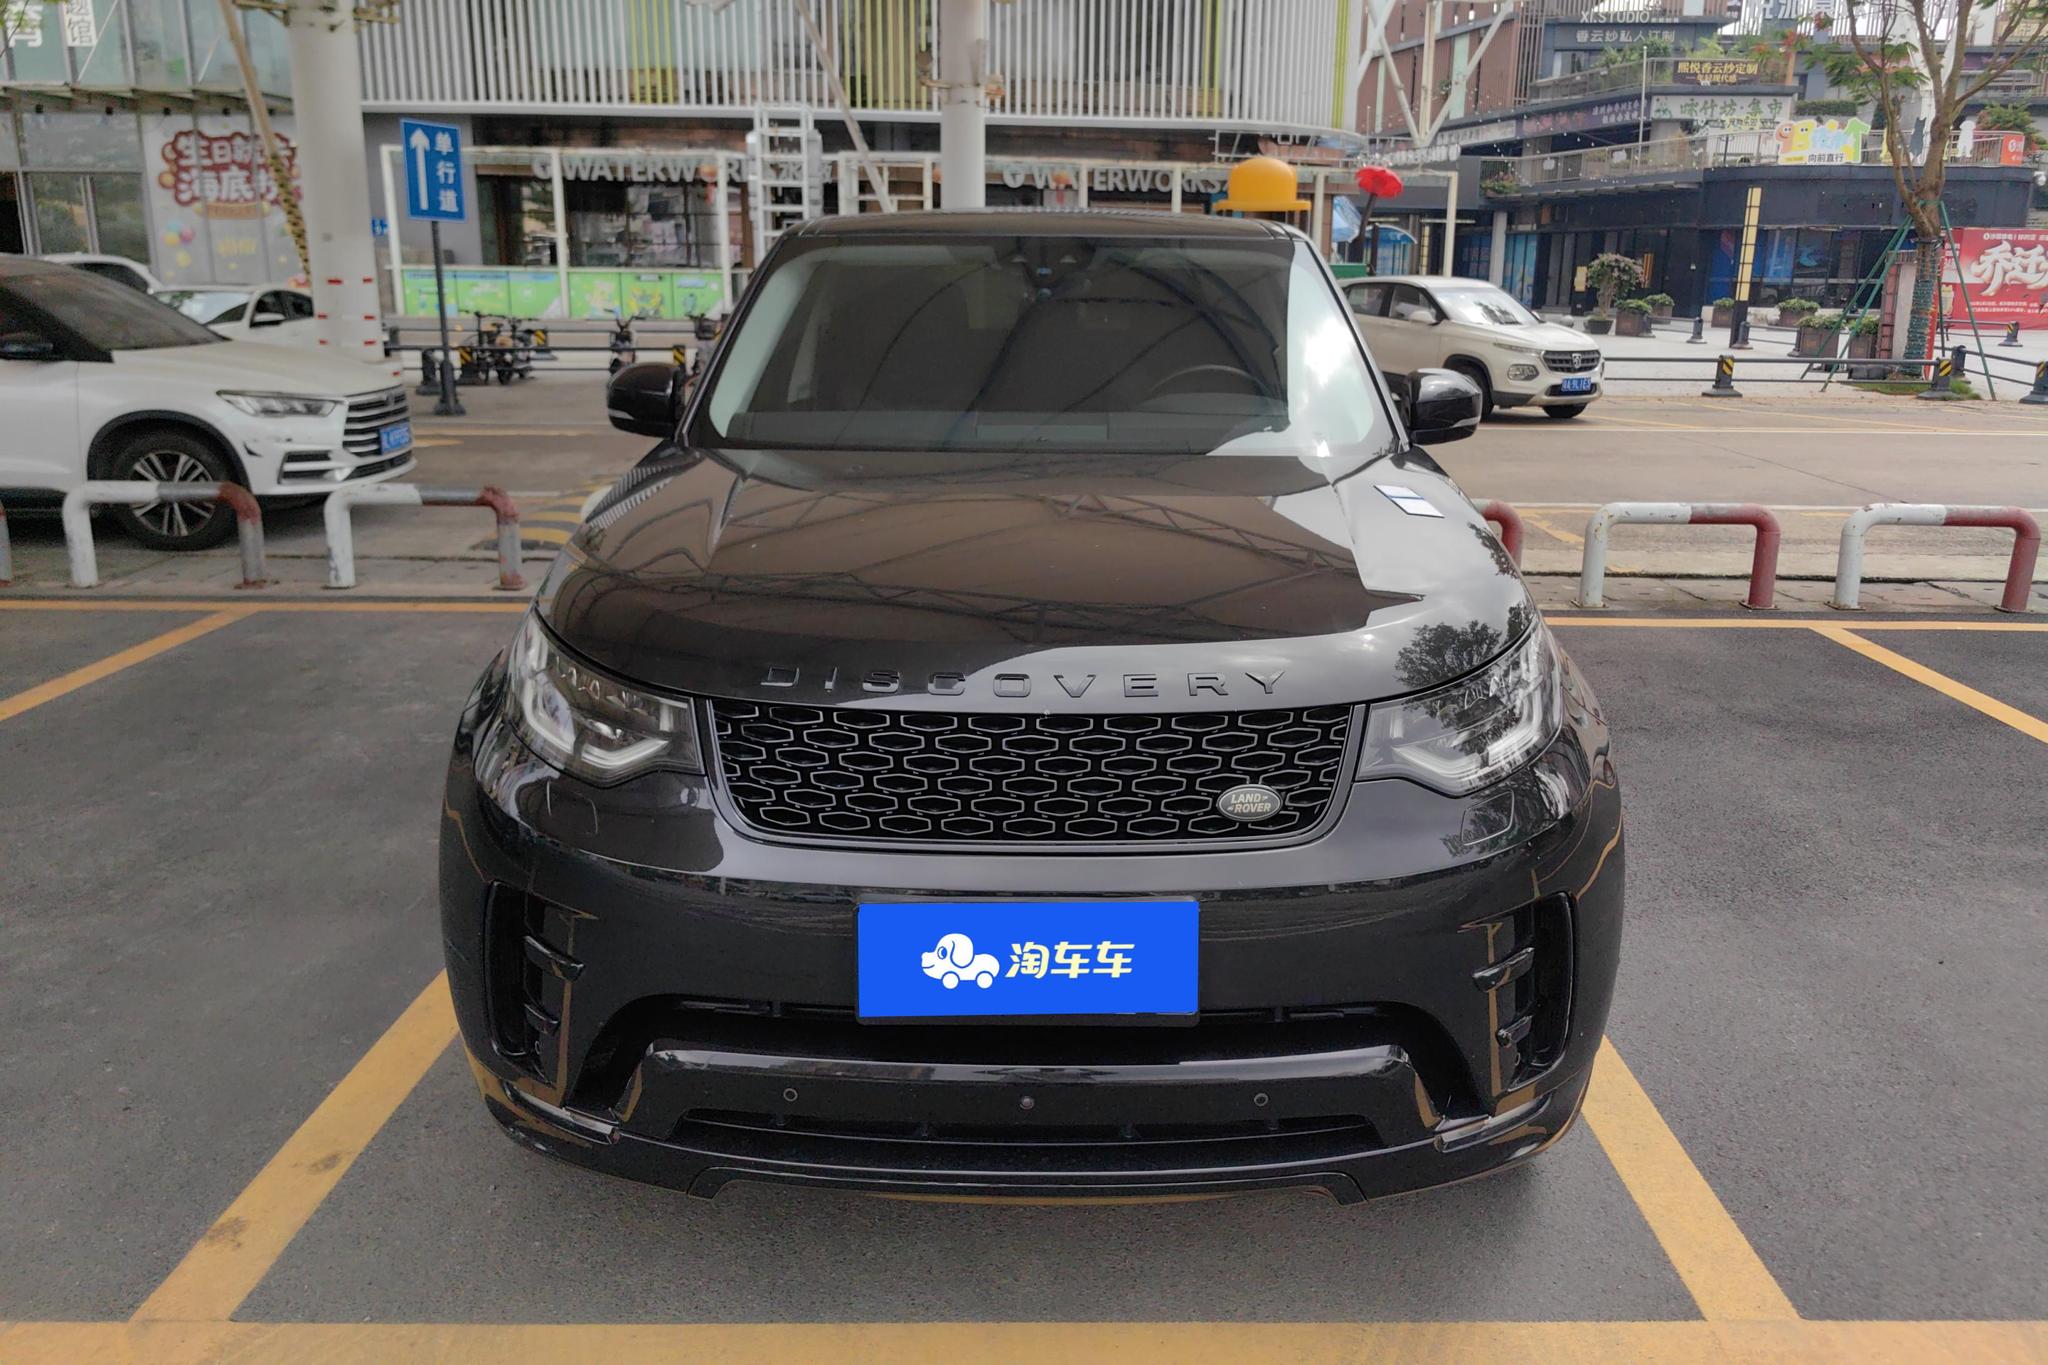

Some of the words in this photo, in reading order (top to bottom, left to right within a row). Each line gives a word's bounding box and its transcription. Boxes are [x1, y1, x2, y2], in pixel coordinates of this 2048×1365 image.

[434, 130, 459, 212] 单行道
[1808, 153, 1845, 163] 向前直行
[1032, 165, 1221, 193] WERWORKS
[1970, 239, 2048, 297] 乔迁
[760, 664, 1287, 699] DISCOVERY
[1230, 793, 1262, 804] LAND
[1234, 802, 1272, 814] ROVER
